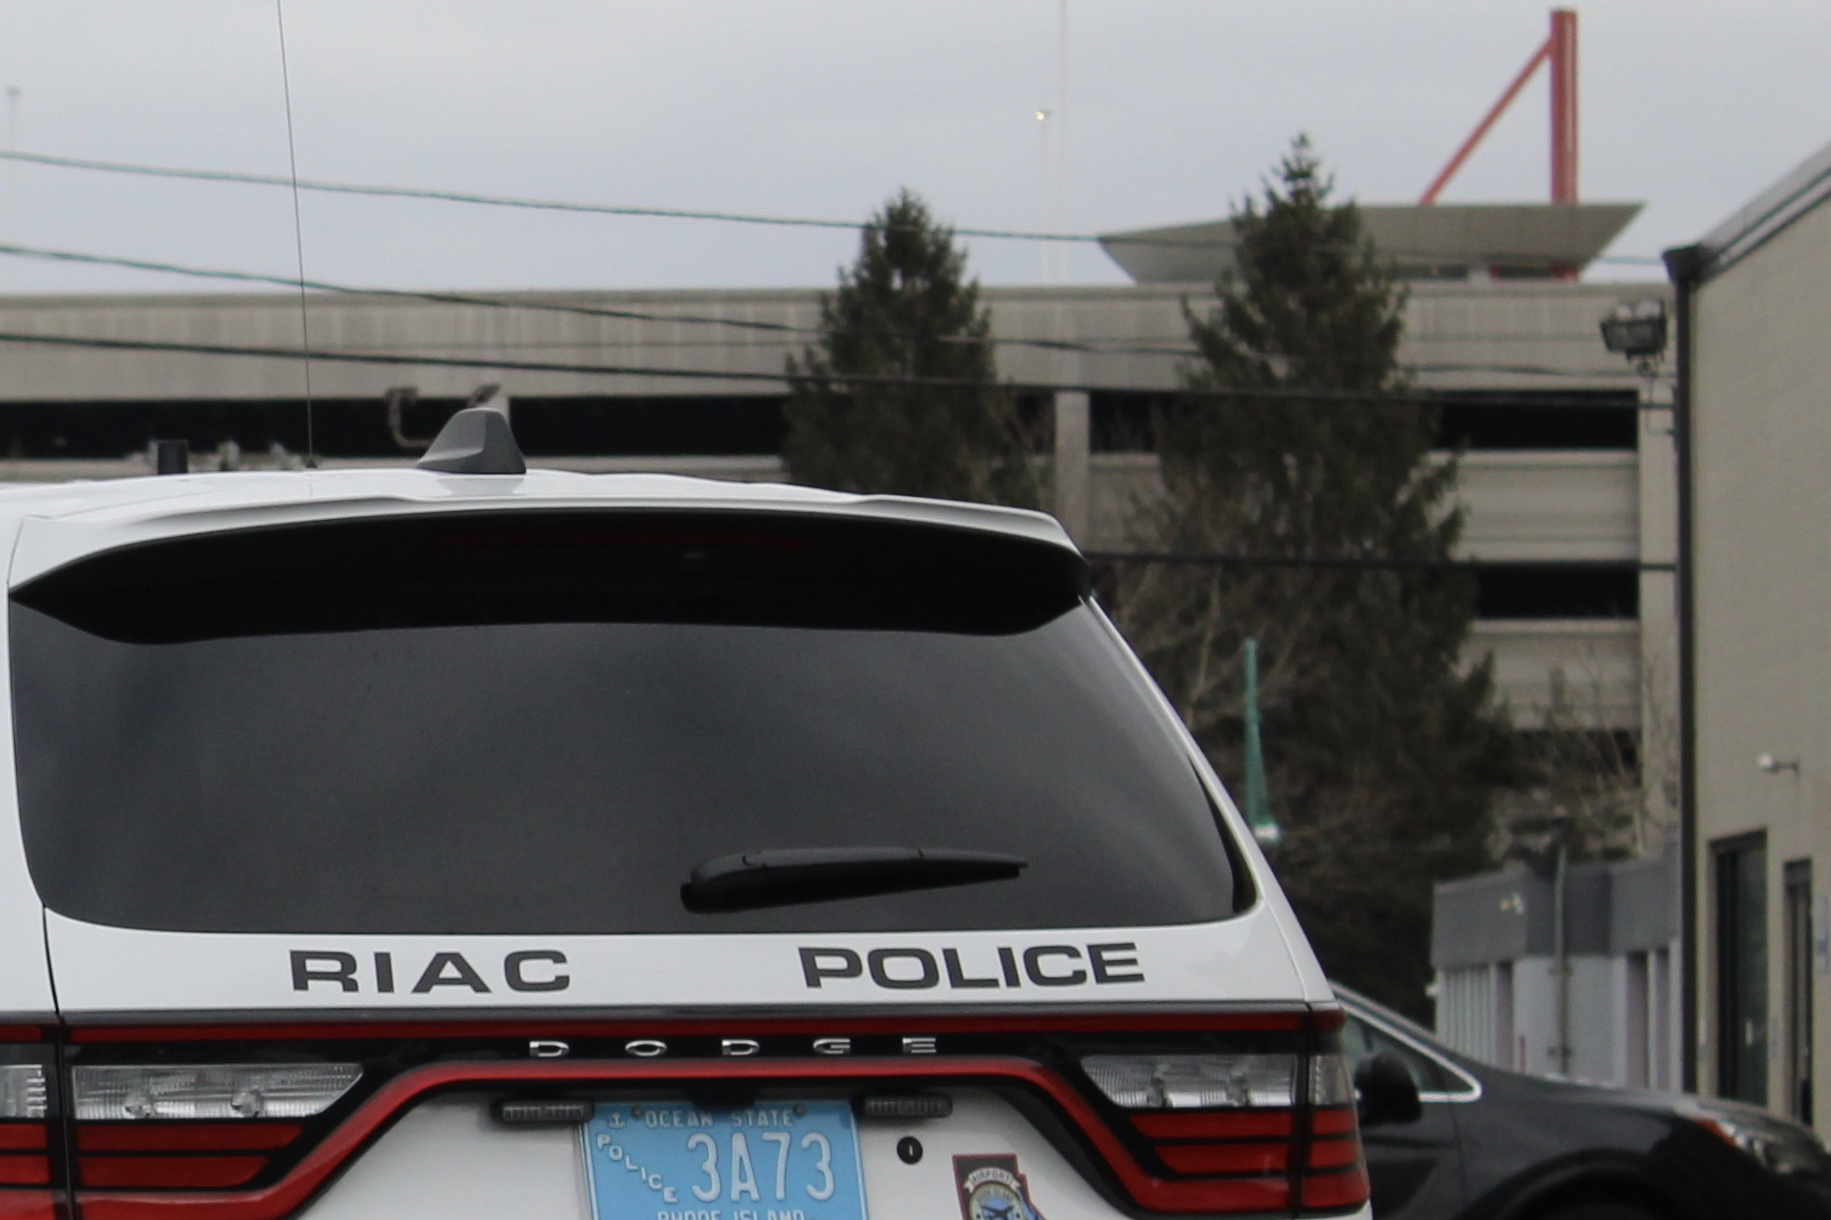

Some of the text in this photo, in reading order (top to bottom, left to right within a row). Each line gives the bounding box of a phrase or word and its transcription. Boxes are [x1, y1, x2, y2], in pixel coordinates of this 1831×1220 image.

[289, 943, 1146, 995] RIAC POLICE
[528, 1037, 938, 1058] DODGE
[645, 1109, 794, 1128] OCEAN STATE
[596, 1133, 678, 1203] POLICE
[687, 1132, 835, 1202] 3A73
